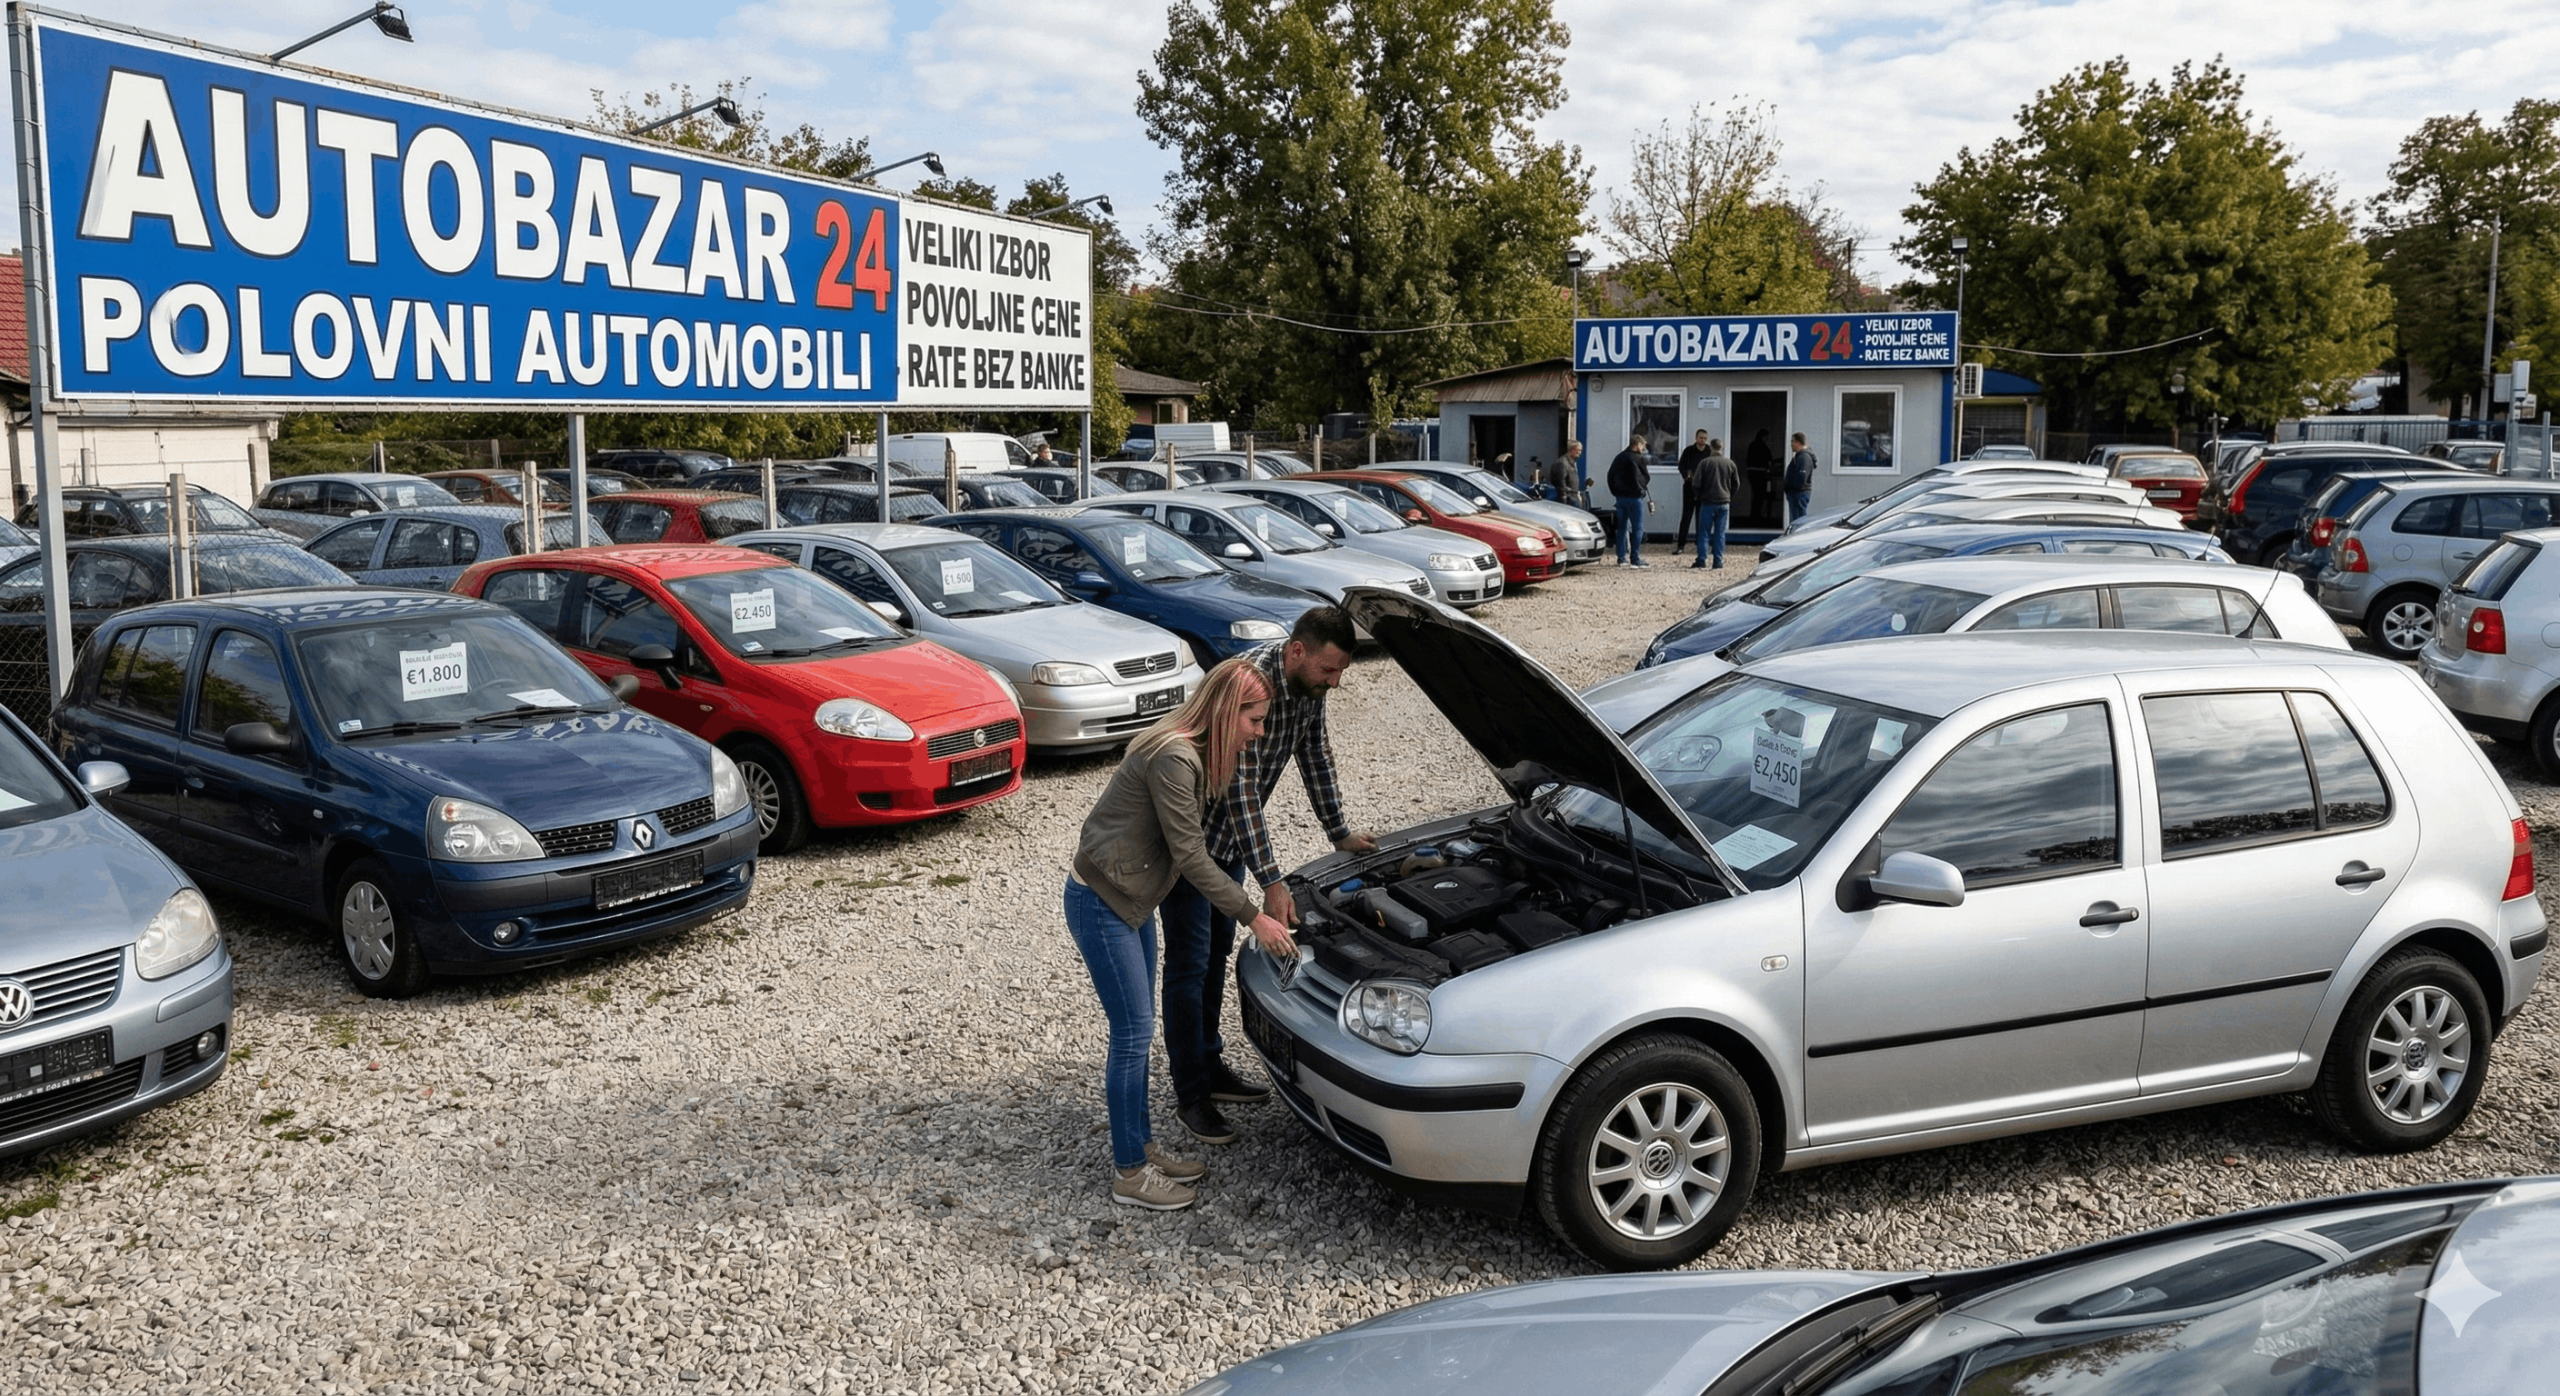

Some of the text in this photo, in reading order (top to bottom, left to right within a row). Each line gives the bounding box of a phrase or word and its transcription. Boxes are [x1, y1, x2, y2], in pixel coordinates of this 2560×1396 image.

[79, 68, 892, 312] AUTOBAZAR 24
[905, 218, 1051, 282] VELIKI IZBOR
[906, 280, 1081, 339] POVOLJNE CENE
[1865, 317, 1933, 332] VELIKI IZBOR
[80, 276, 872, 391] POLOVNI AUTOMOBILI
[1582, 321, 1853, 364] AUTOBAZAR 24
[1865, 332, 1948, 347] POVOLJNE CENE
[907, 343, 1085, 391] RATE BEZ BANKE
[1864, 347, 1950, 361] RATE BEZ BANKE
[734, 604, 772, 620] €2.450
[406, 663, 462, 685] €1.800
[1753, 754, 1798, 787] €2,450
